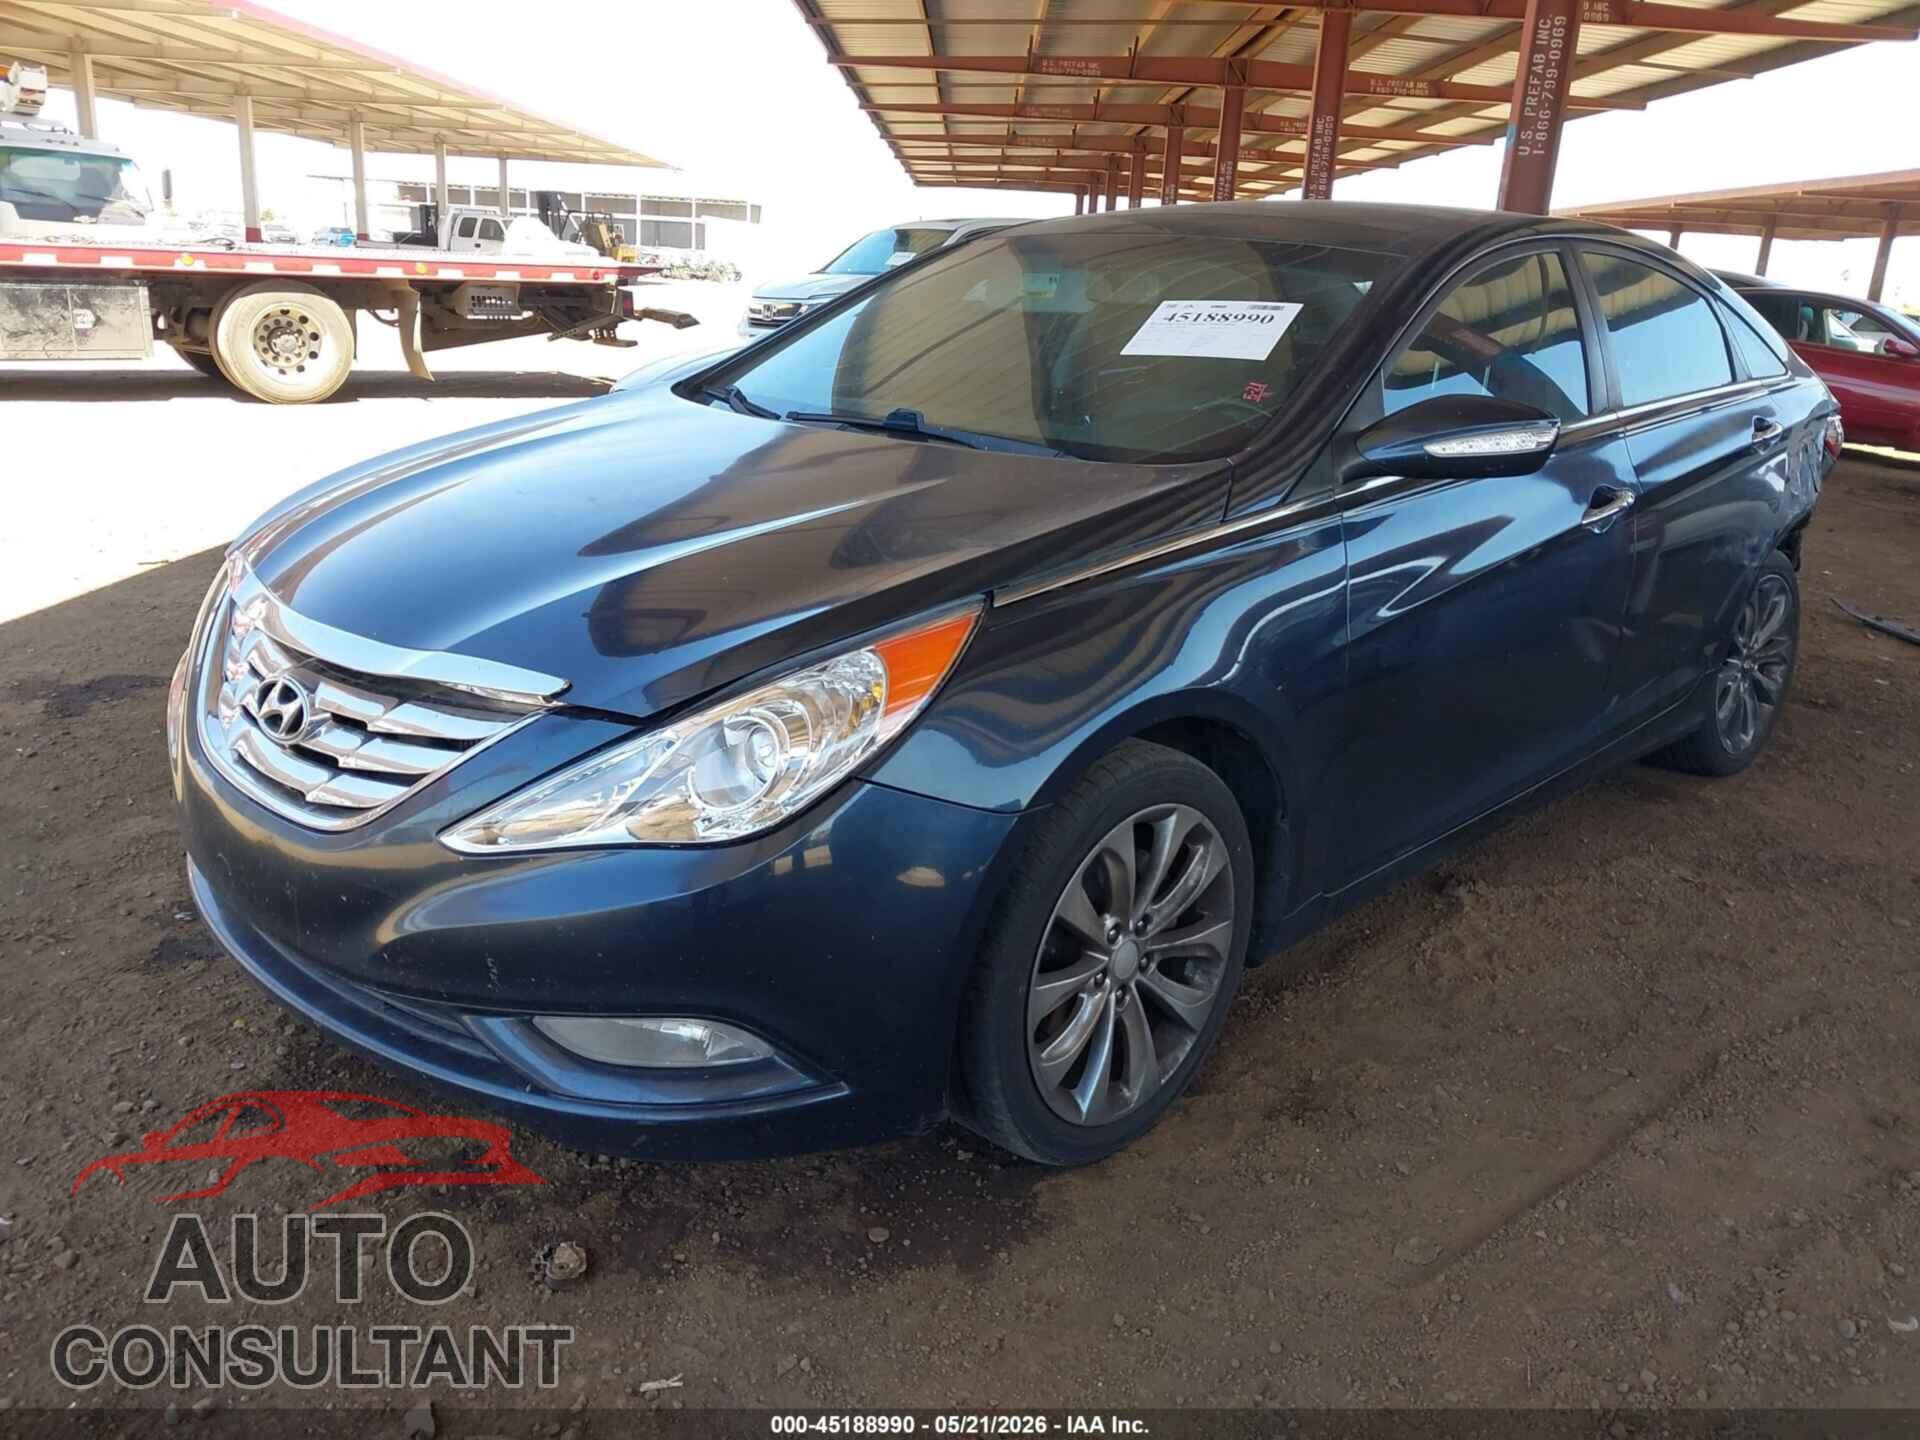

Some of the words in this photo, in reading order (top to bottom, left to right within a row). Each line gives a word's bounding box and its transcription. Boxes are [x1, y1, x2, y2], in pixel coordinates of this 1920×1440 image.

[1535, 14, 1553, 44] INC.
[1523, 53, 1546, 117] PREFAB
[1533, 15, 1567, 155] 1-866-799-0969
[1518, 125, 1535, 155] U.S.
[1163, 311, 1275, 324] 45188990
